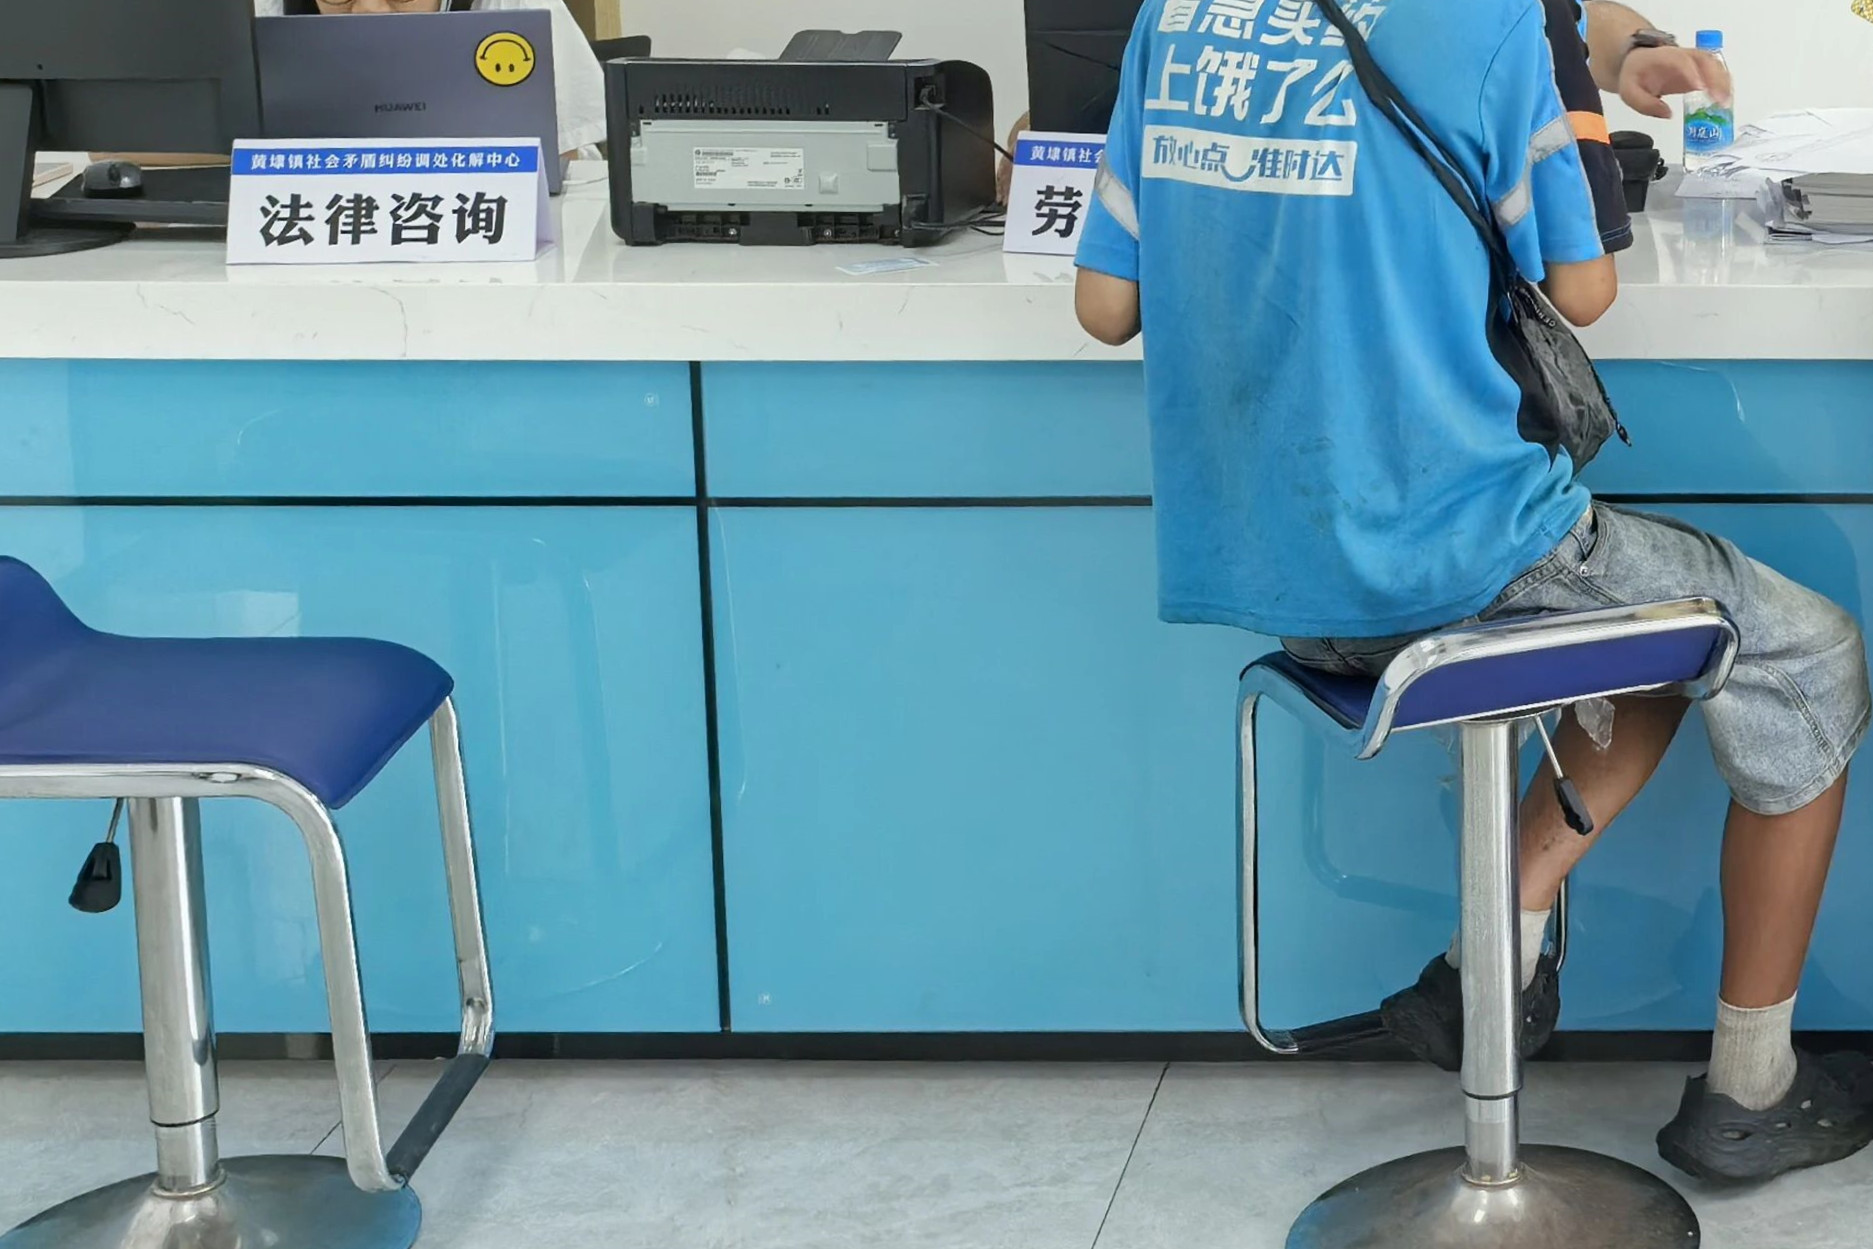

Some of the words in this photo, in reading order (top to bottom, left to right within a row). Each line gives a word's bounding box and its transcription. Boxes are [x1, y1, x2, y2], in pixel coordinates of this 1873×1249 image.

[374, 102, 427, 113] HUAWEI
[1145, 44, 1357, 127] 上饿了么
[251, 152, 521, 170] 黄埭镇社会矛盾纠纷调处化解中心
[259, 192, 508, 246] 法律咨询
[1032, 185, 1083, 238] 劳
